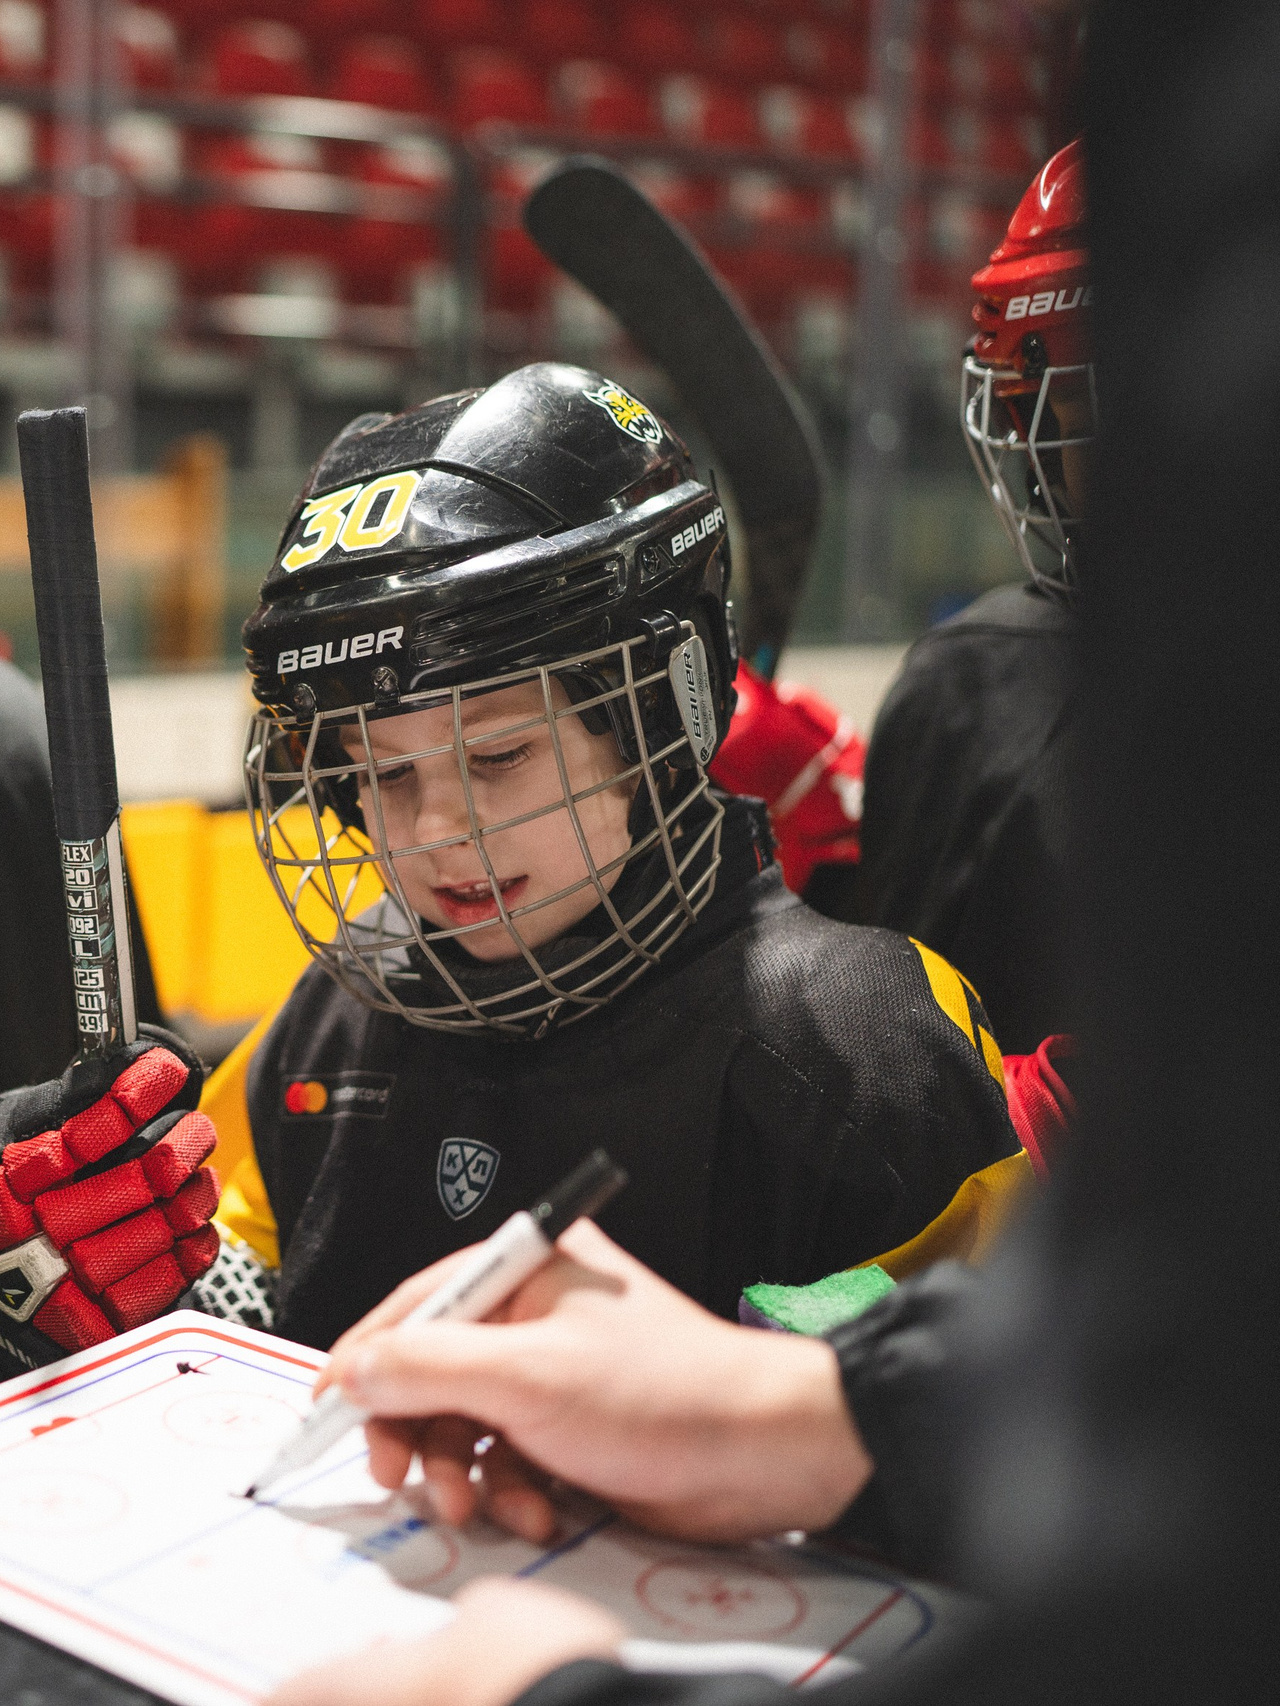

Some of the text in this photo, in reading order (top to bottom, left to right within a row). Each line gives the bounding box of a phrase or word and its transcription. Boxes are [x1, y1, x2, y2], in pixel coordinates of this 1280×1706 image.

[281, 469, 422, 573] 30
[671, 505, 724, 557] BAUER
[277, 625, 404, 674] BAUER
[65, 868, 90, 885] 20
[75, 940, 92, 956] L
[75, 970, 99, 986] 125
